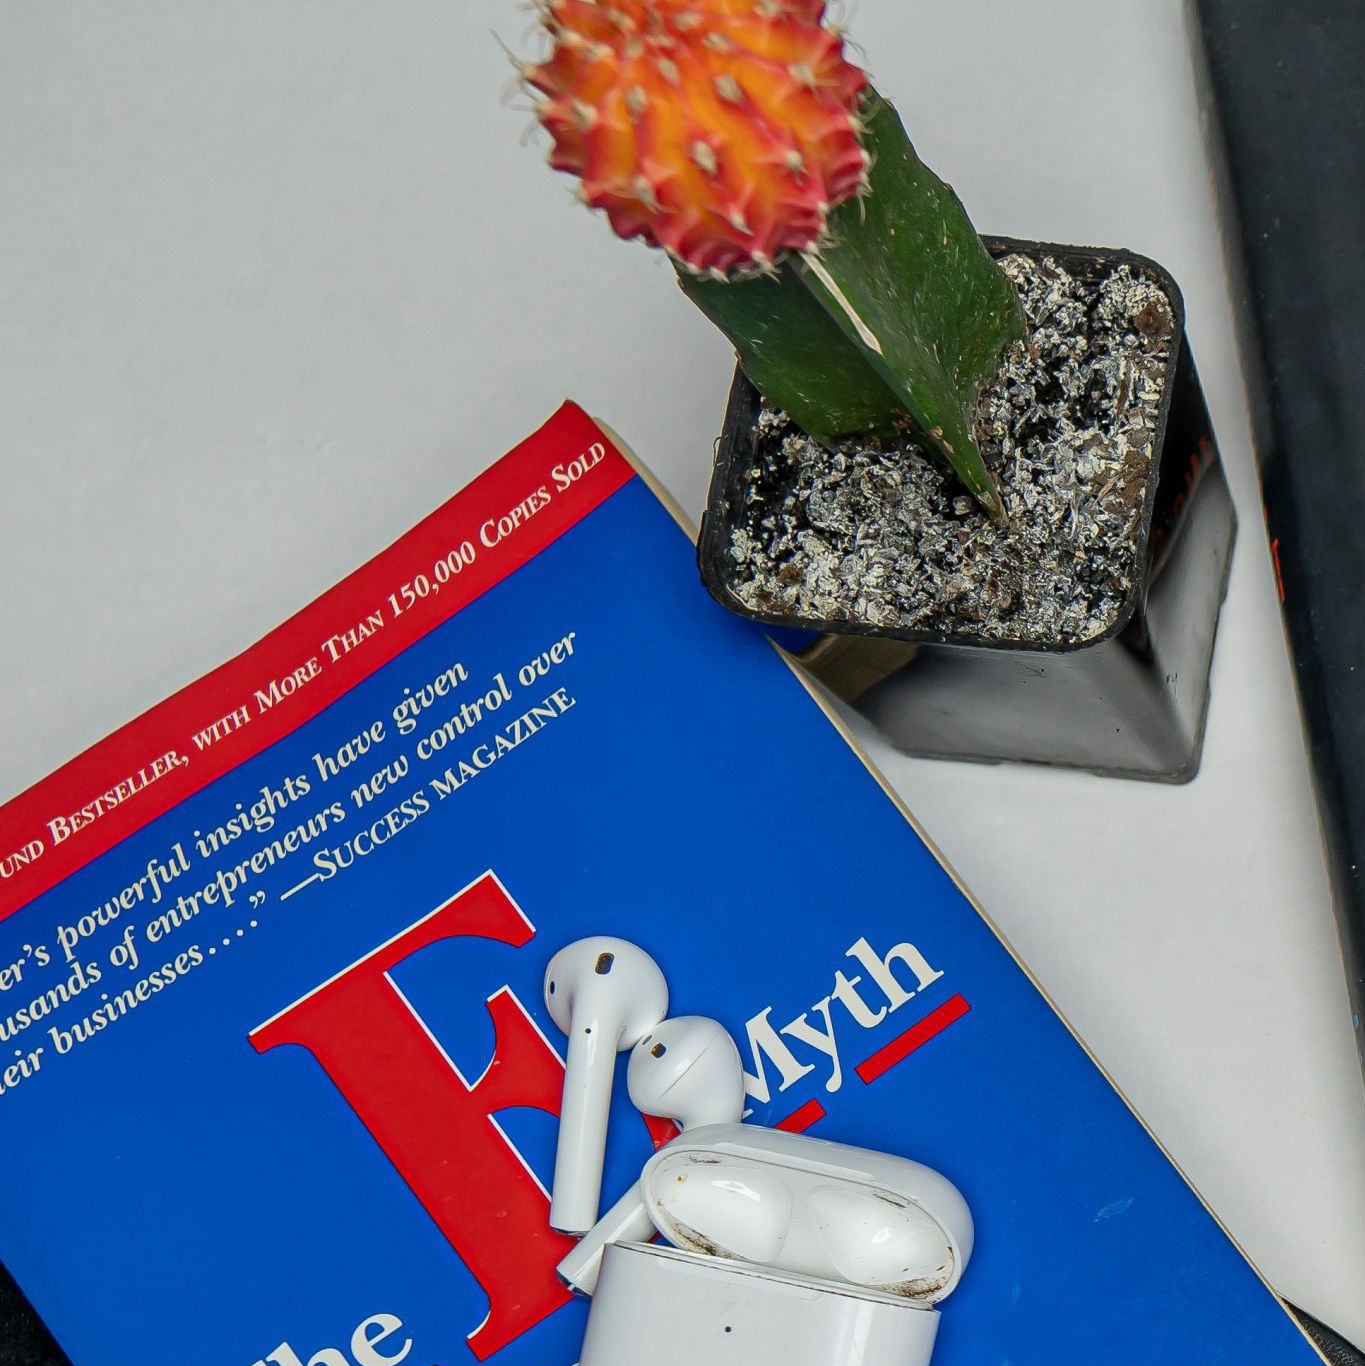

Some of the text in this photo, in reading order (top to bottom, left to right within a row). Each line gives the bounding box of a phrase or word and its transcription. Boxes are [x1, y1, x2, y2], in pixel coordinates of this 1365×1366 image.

[47, 751, 188, 845] BESTSELLER,
[193, 706, 250, 750] WITH
[254, 658, 321, 713] MORE
[322, 610, 383, 662] THAN
[389, 542, 475, 616] 150,000
[480, 487, 551, 547] COPIES
[552, 443, 604, 492] SOLD
[430, 688, 575, 799] MAGAZINE
[58, 843, 190, 962] powerful
[197, 776, 310, 857] insights
[312, 722, 385, 781] have
[393, 664, 467, 734] given
[111, 926, 138, 969] of
[147, 803, 345, 941] entrepreneurs
[352, 756, 407, 808] new
[418, 673, 511, 759] control
[519, 633, 575, 685] over
[743, 937, 945, 1117] Myth
